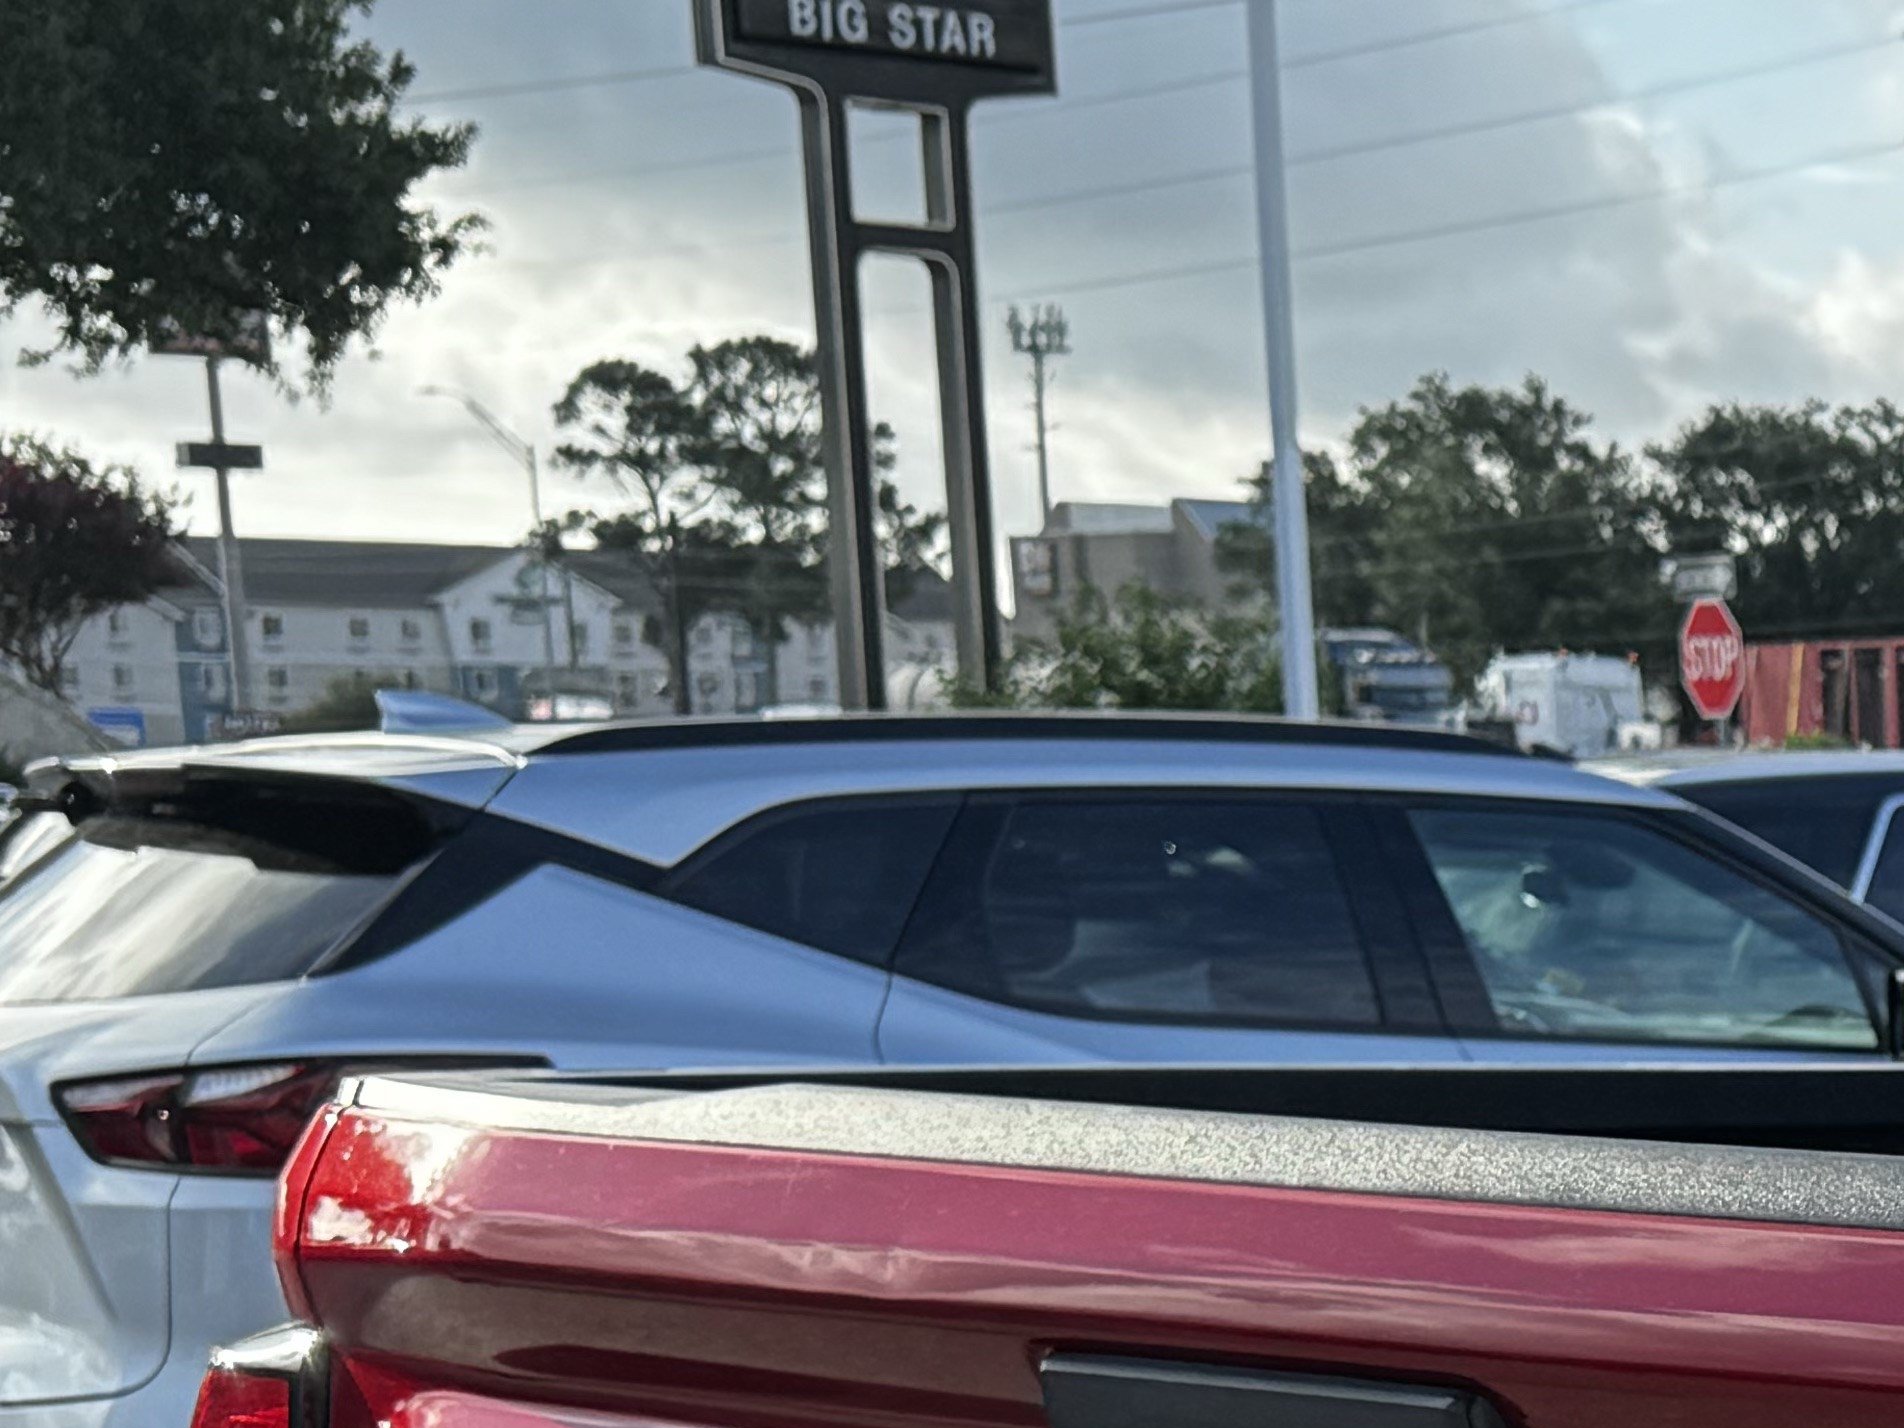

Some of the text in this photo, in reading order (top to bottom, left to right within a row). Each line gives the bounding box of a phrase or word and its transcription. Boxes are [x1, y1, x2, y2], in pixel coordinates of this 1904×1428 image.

[789, 0, 997, 59] BIG STAR
[1683, 636, 1739, 681] STOP
